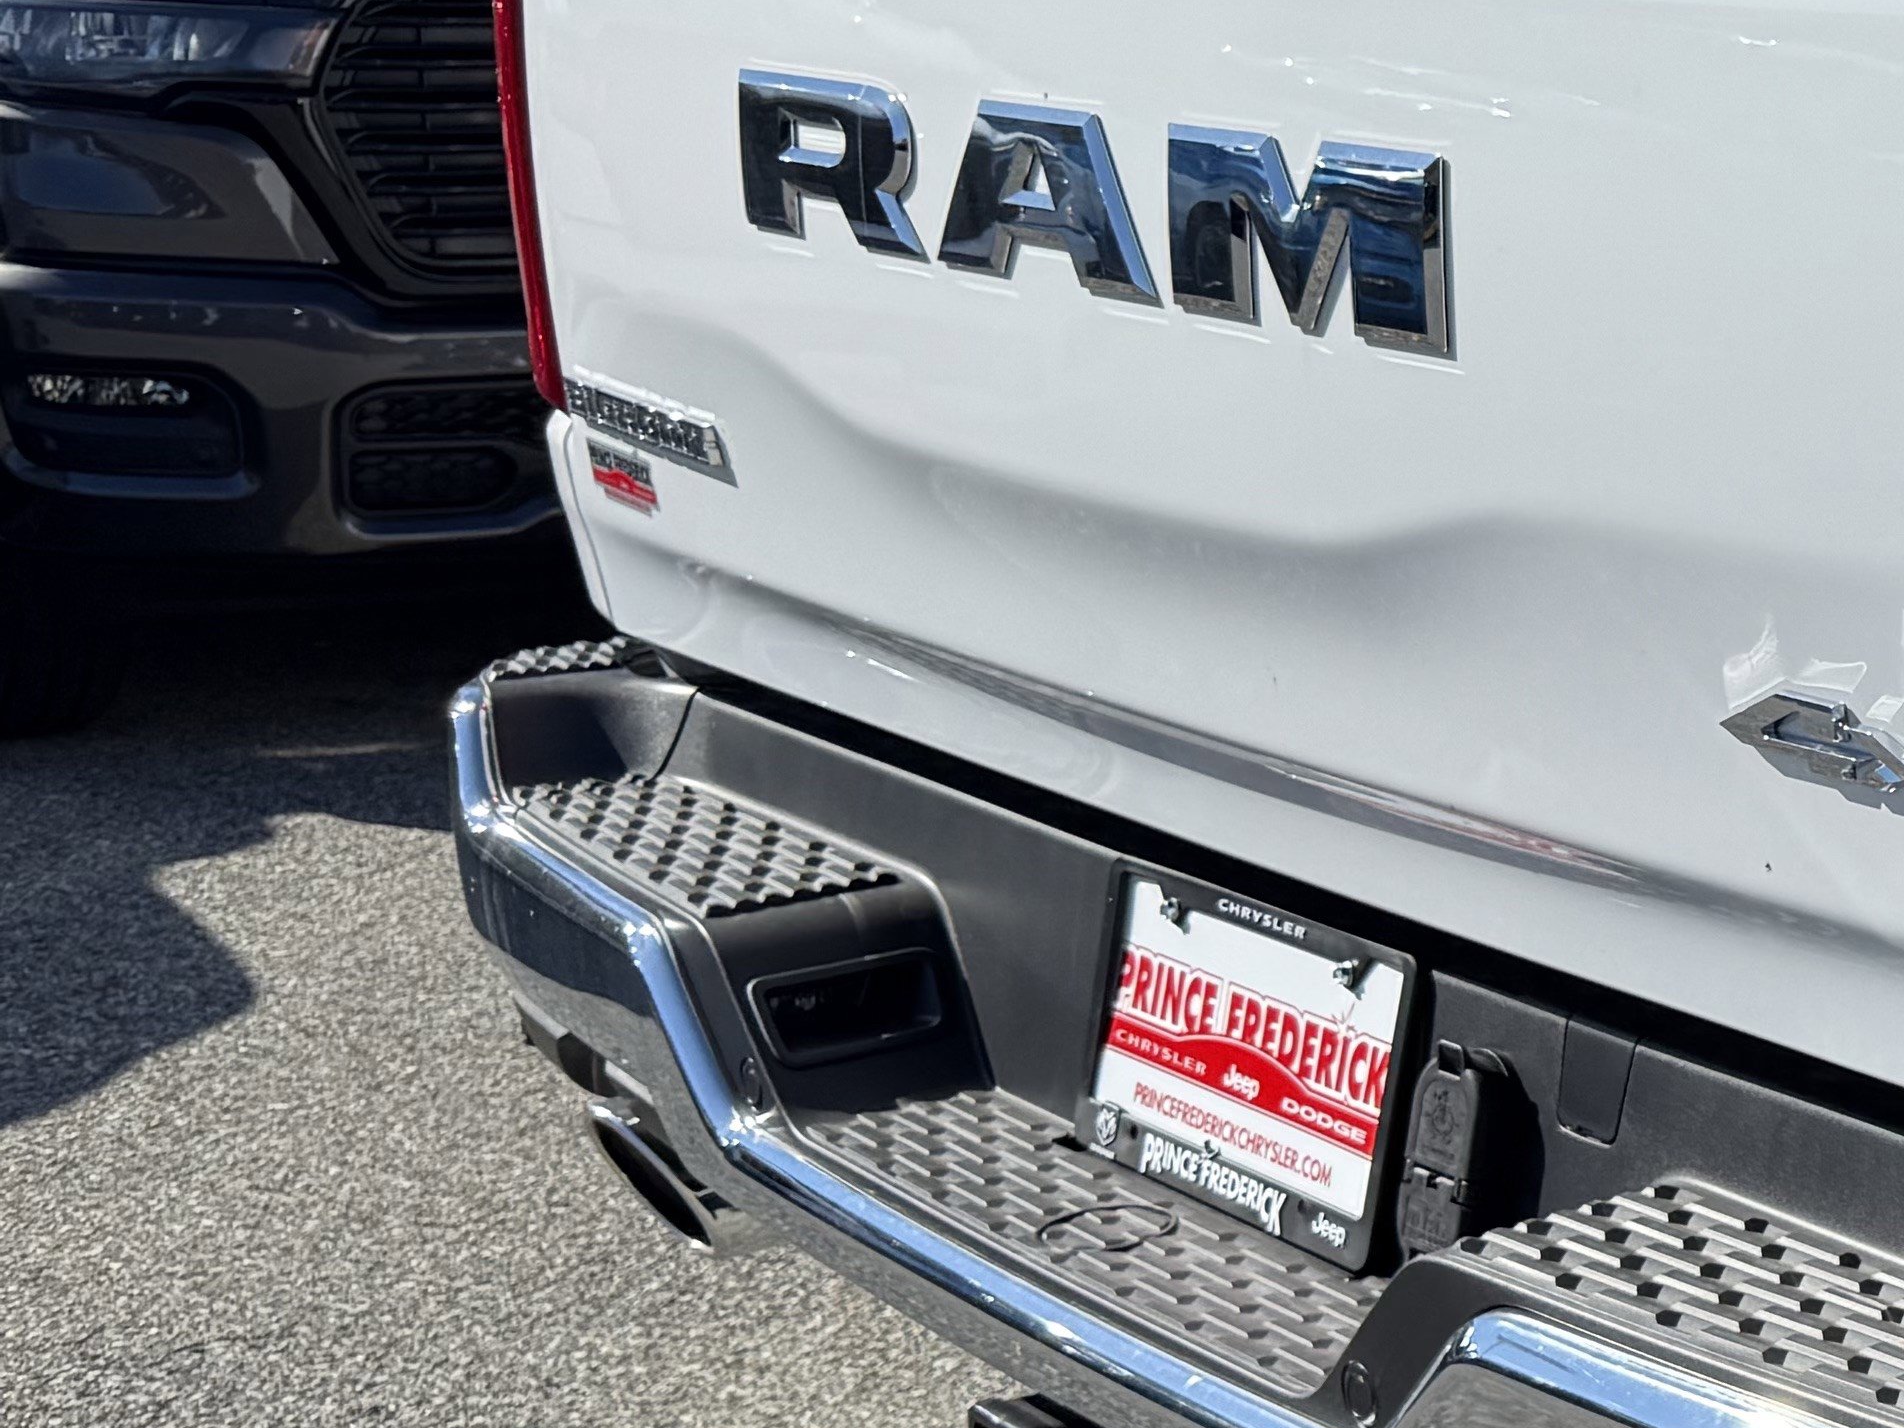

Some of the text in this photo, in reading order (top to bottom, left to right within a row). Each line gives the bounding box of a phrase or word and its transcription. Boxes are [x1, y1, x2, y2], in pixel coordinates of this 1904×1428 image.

[736, 67, 1457, 359] RAM
[1216, 897, 1308, 941] CHRYSLER
[1117, 947, 1223, 1035] PRINCE
[1114, 1027, 1369, 1147] CHRYSLER Jeep DODGE
[1226, 990, 1392, 1112] FREDERICK
[1133, 1081, 1333, 1188] PRINCEFREDERICKCHRYSLER.COM
[1139, 1132, 1289, 1237] PRINCE FREDERICK
[1310, 1210, 1348, 1249] Jeep
